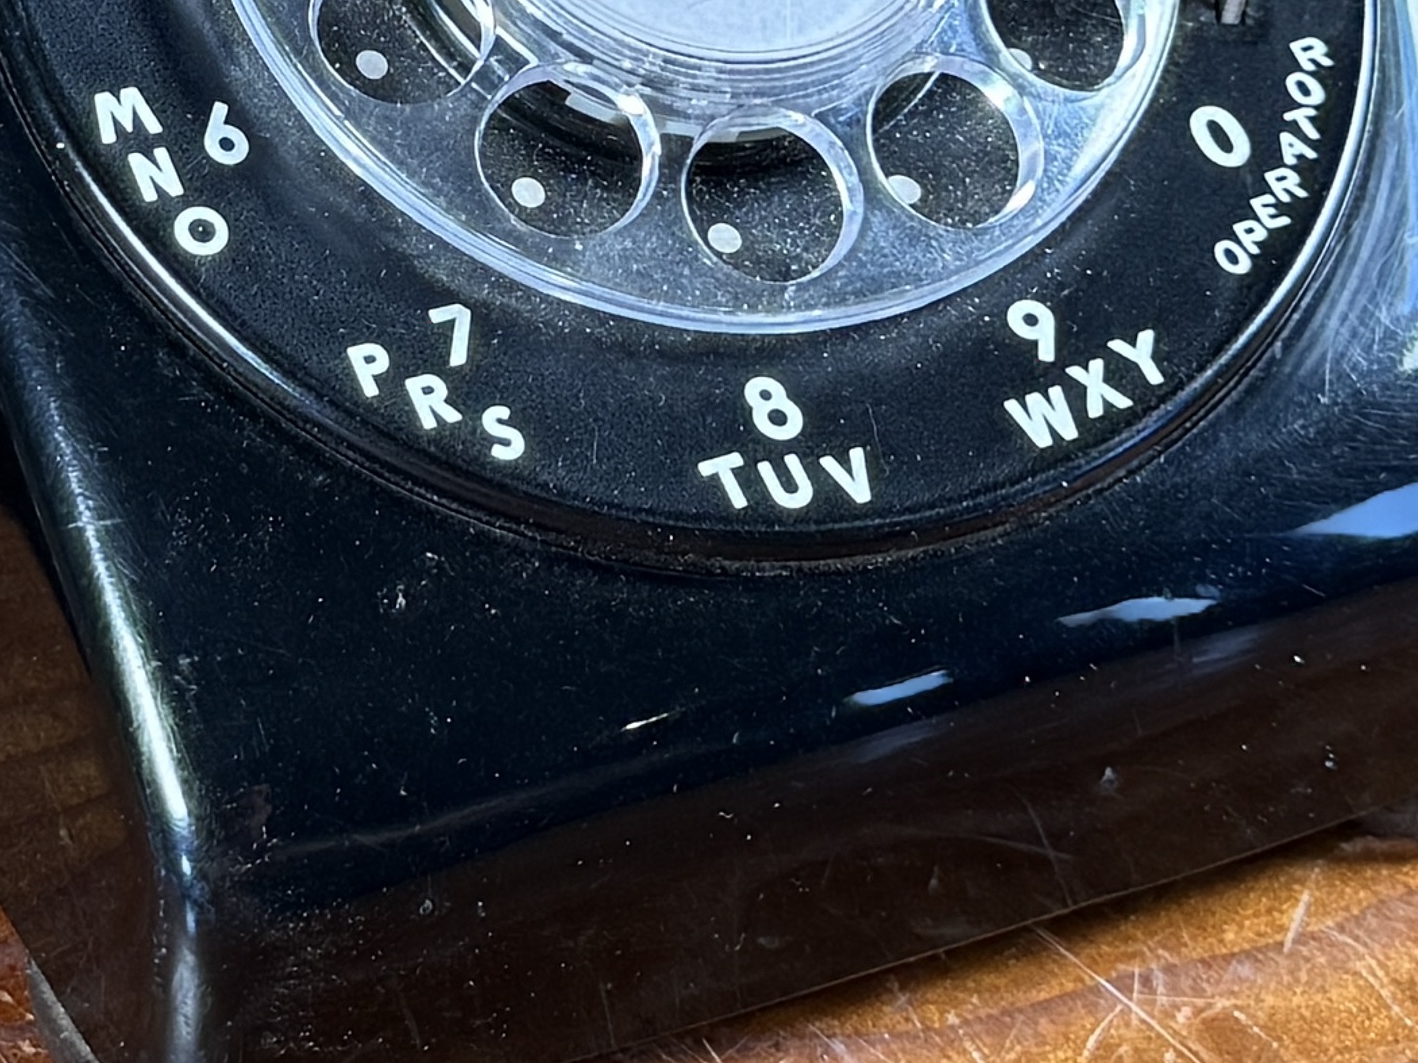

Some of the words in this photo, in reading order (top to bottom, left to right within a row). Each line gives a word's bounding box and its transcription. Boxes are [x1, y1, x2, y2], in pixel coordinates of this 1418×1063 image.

[203, 101, 250, 166] 6
[1213, 36, 1335, 275] OPERATOR
[93, 86, 230, 257] MNO
[427, 303, 472, 368] 7
[1006, 299, 1056, 363] 9
[346, 342, 526, 461] PRS
[743, 376, 804, 441] 8
[1003, 328, 1165, 449] WXY
[697, 446, 872, 510] TUV
